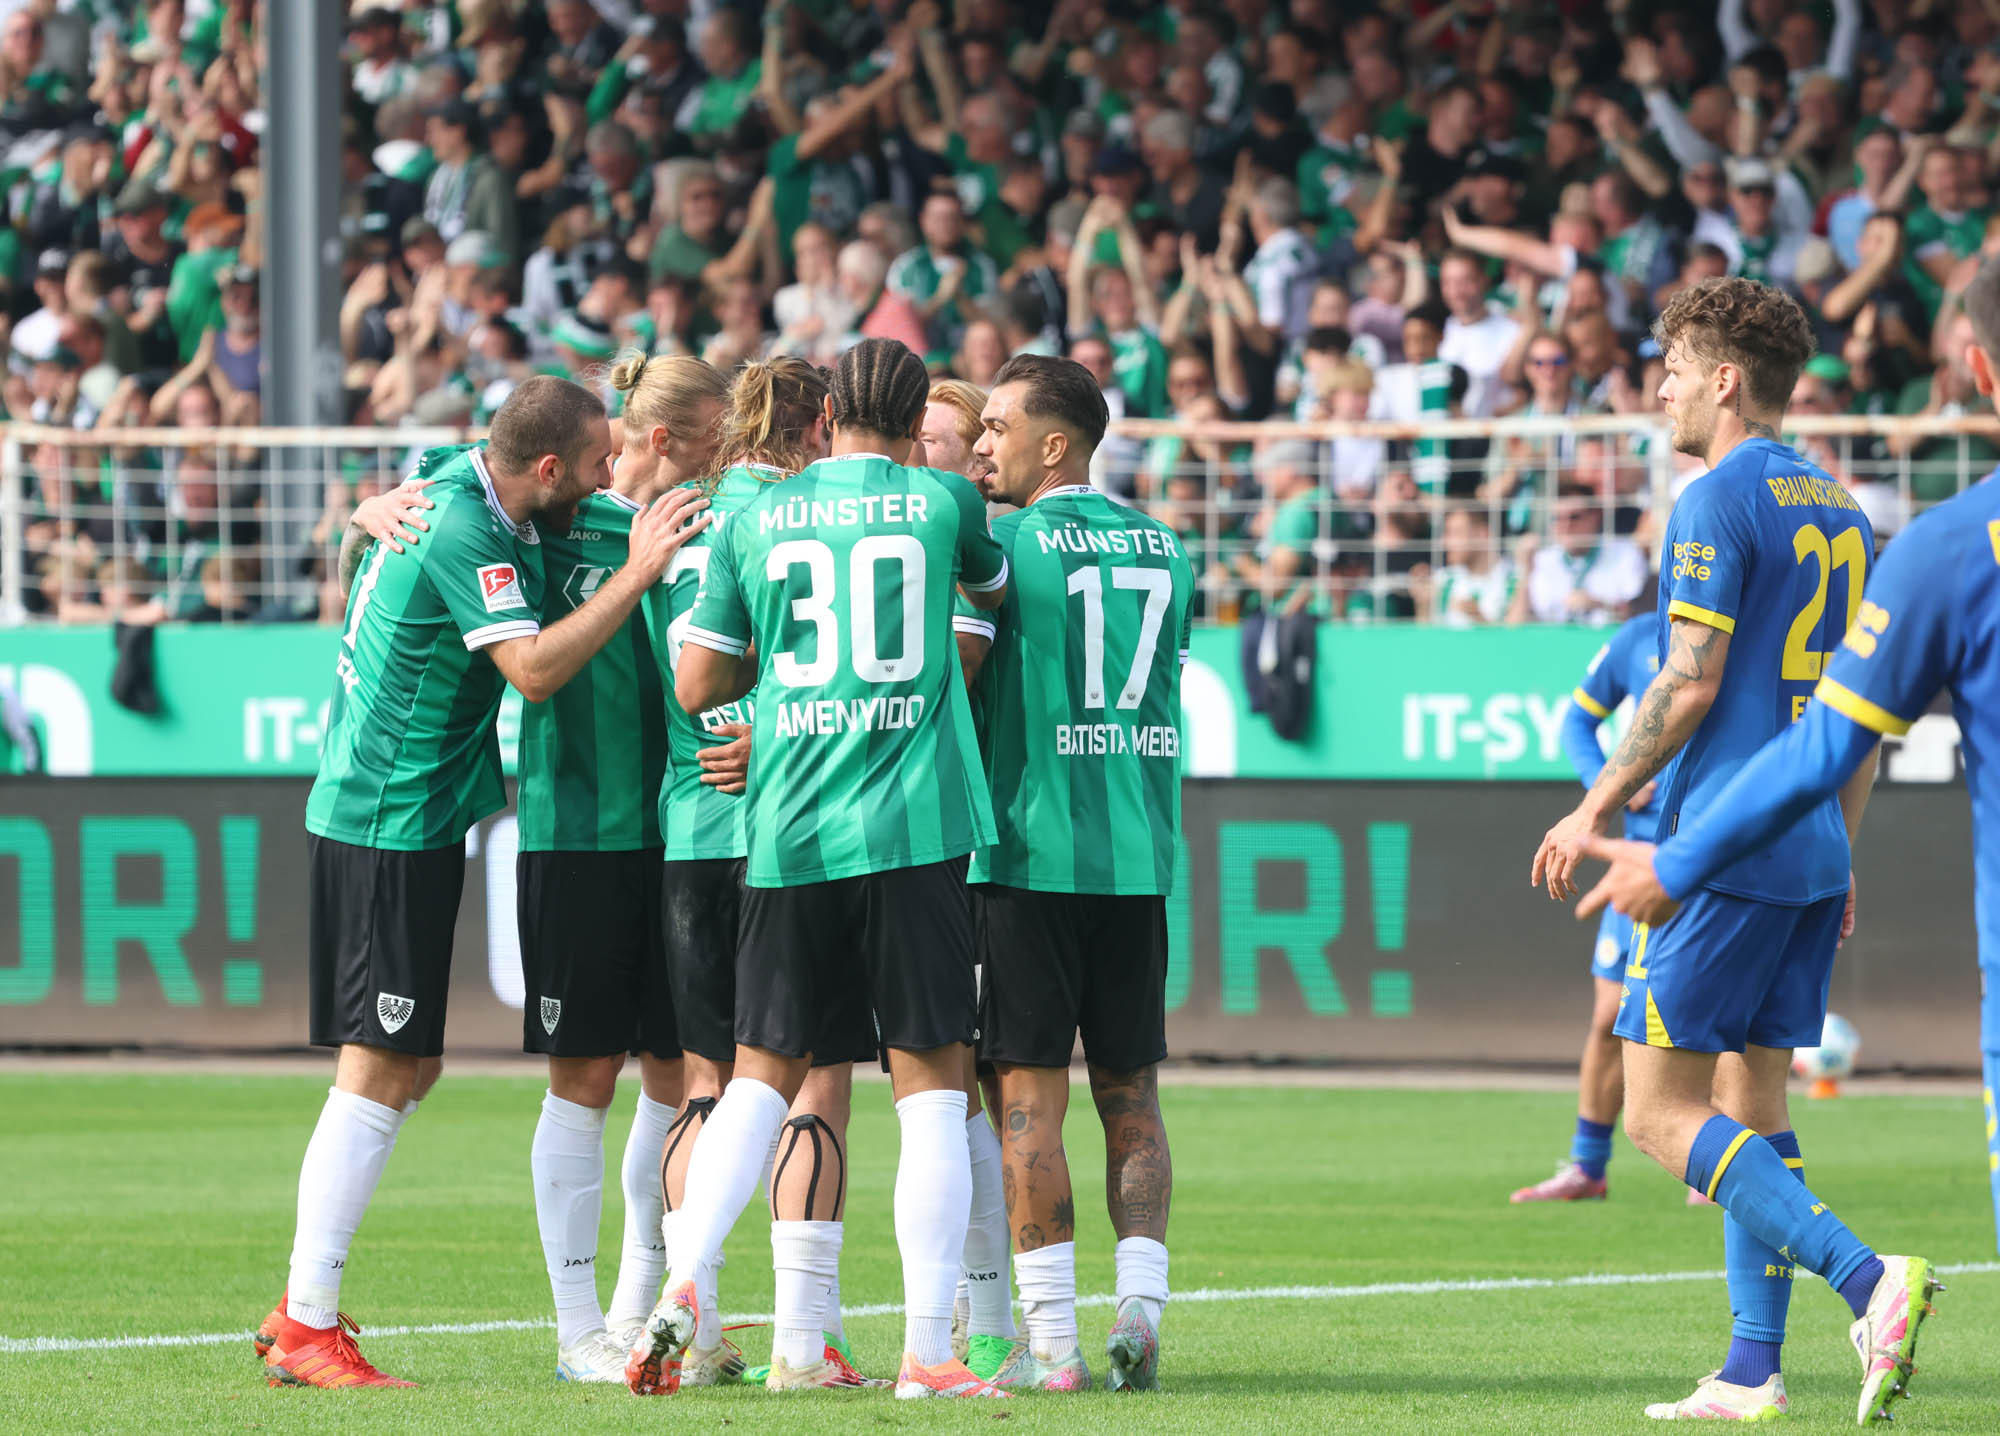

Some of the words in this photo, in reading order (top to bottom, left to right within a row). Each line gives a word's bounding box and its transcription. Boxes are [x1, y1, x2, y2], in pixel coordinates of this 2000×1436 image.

[567, 530, 602, 541] JAKO
[759, 493, 928, 536] MÜNSTER
[1035, 522, 1179, 558] MÜNSTER
[766, 534, 926, 688] 30
[1782, 523, 1867, 680] 21
[1067, 566, 1172, 710] 17
[775, 695, 925, 738] AMENYIDO
[1404, 694, 1568, 762] IT-SY
[1056, 724, 1129, 755] BATISTA
[1765, 1264, 1795, 1280] BTS
